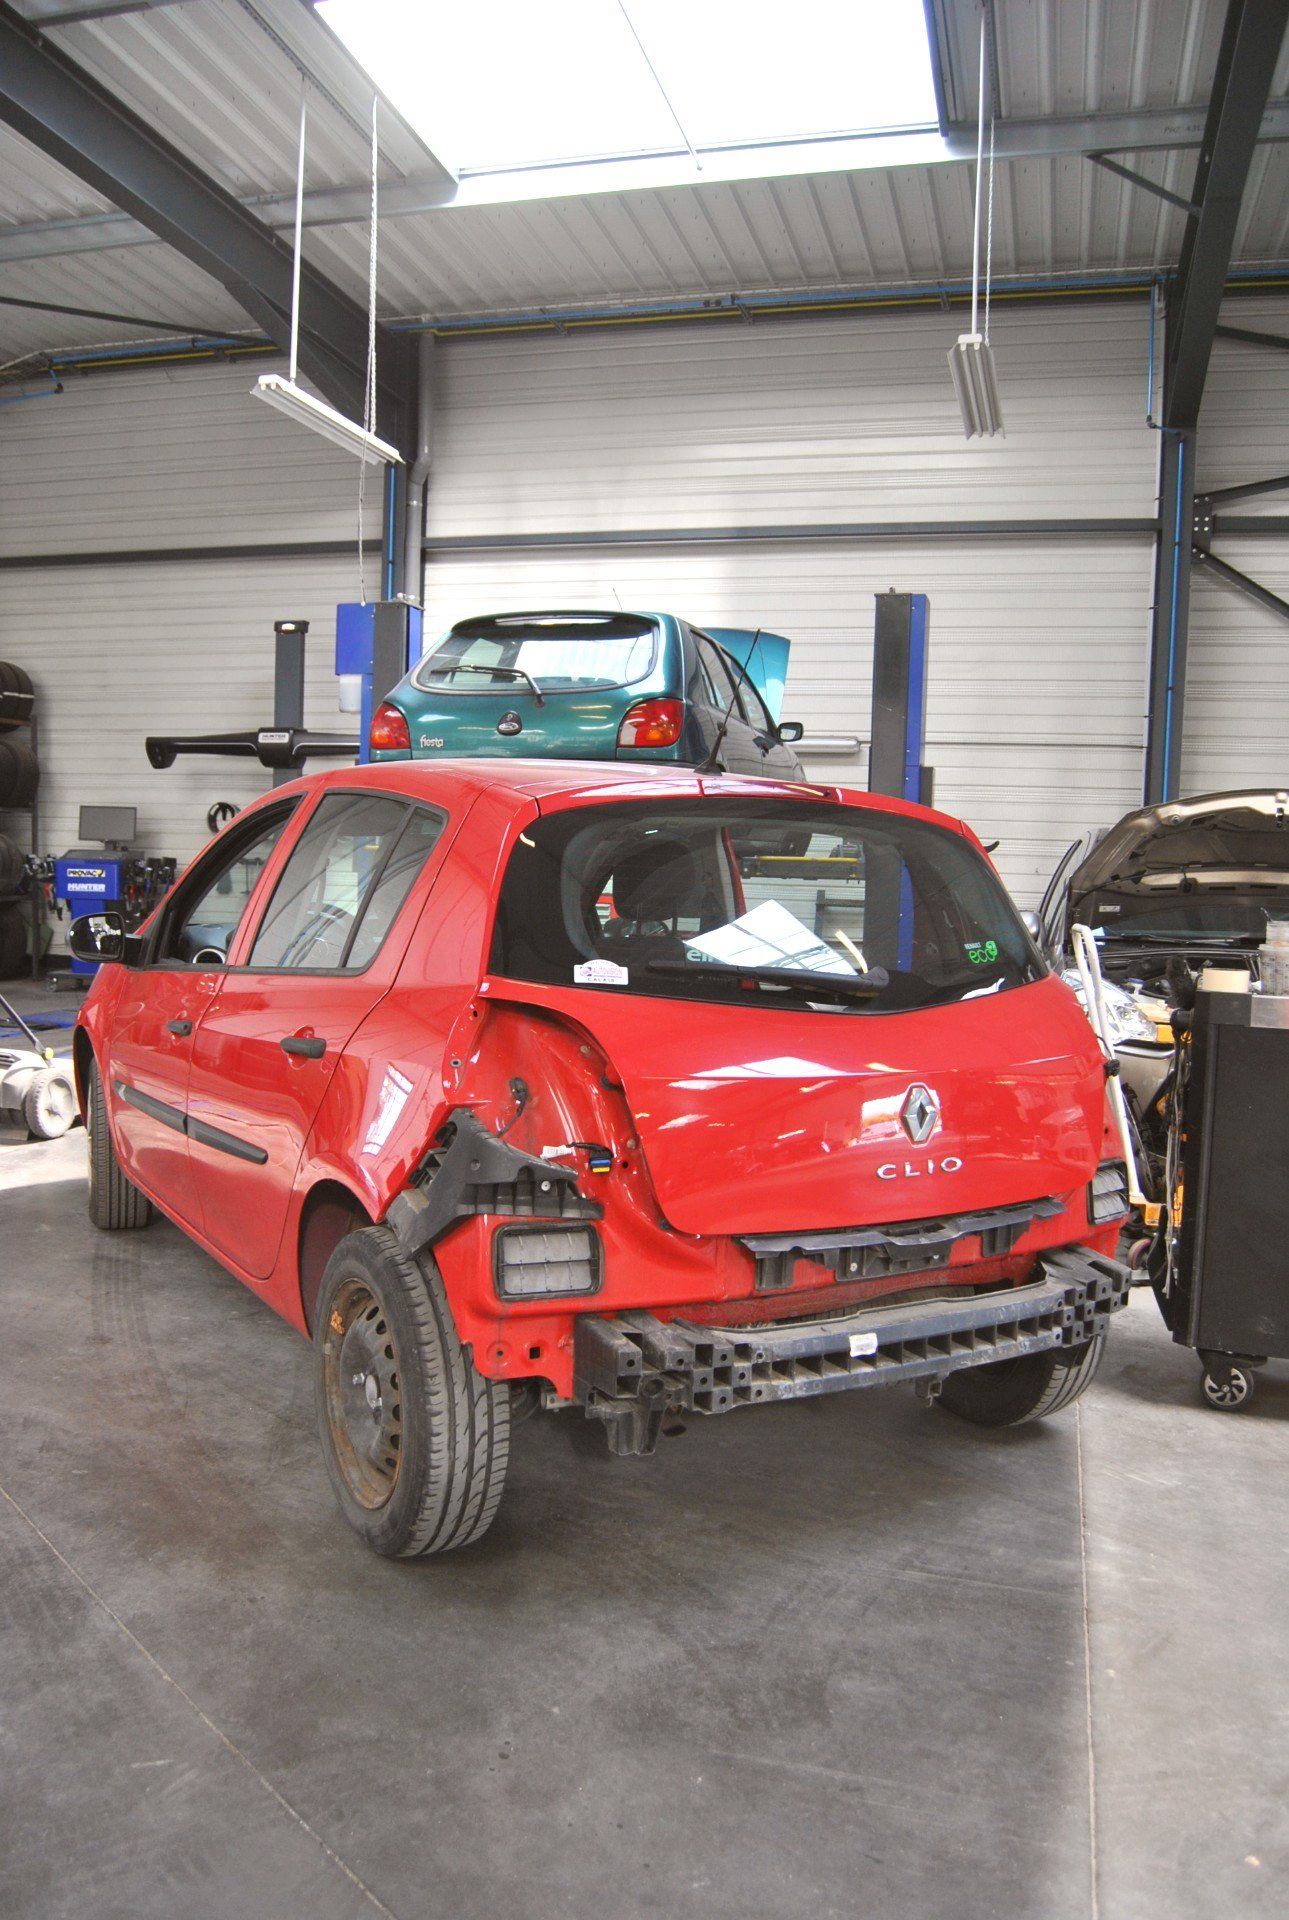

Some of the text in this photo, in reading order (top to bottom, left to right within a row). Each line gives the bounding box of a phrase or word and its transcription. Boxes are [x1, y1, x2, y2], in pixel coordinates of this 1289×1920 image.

[420, 734, 443, 748] fiesta
[67, 883, 106, 892] HUNTER
[877, 1156, 963, 1180] CLIO
